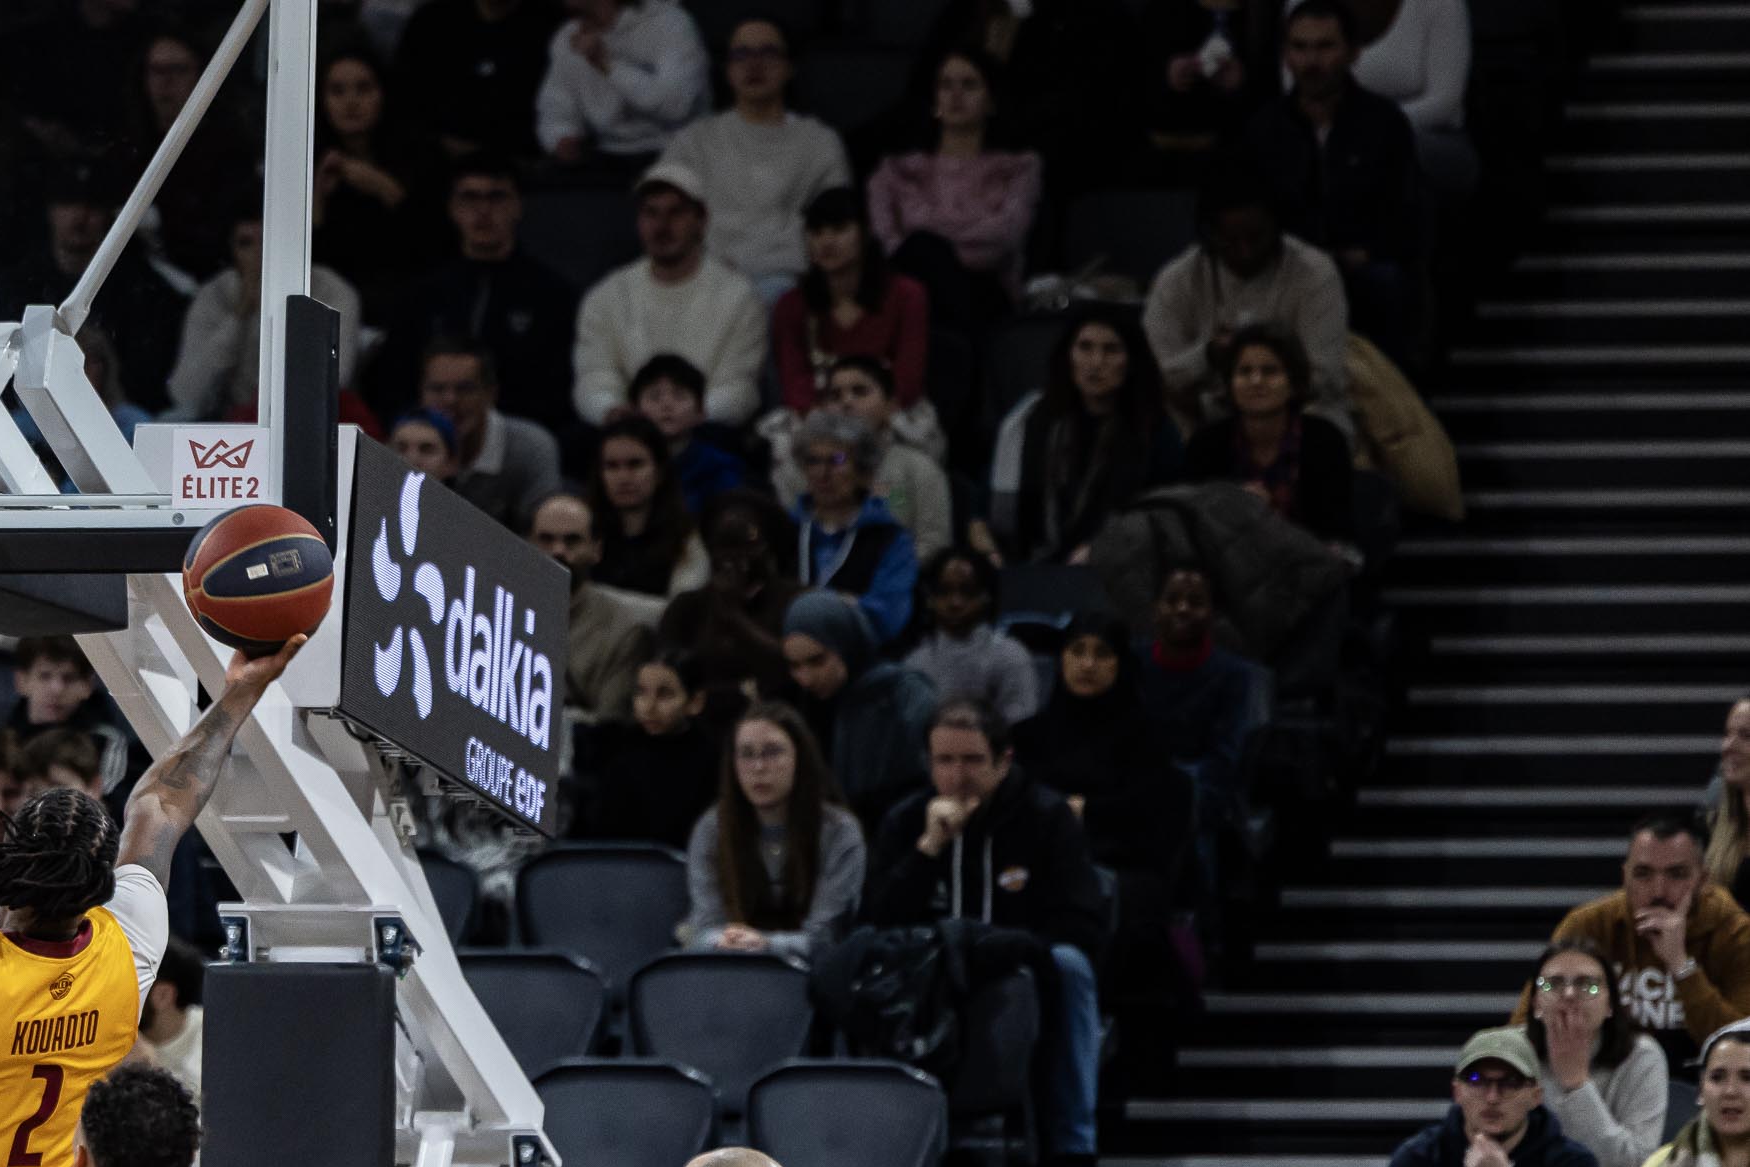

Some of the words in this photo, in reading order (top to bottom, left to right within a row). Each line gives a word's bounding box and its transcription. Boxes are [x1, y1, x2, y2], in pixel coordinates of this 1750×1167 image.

[445, 565, 553, 751] dalkia
[466, 737, 514, 805] GROUPE
[11, 1009, 99, 1056] KOUADIO
[7, 1064, 65, 1167] 2
